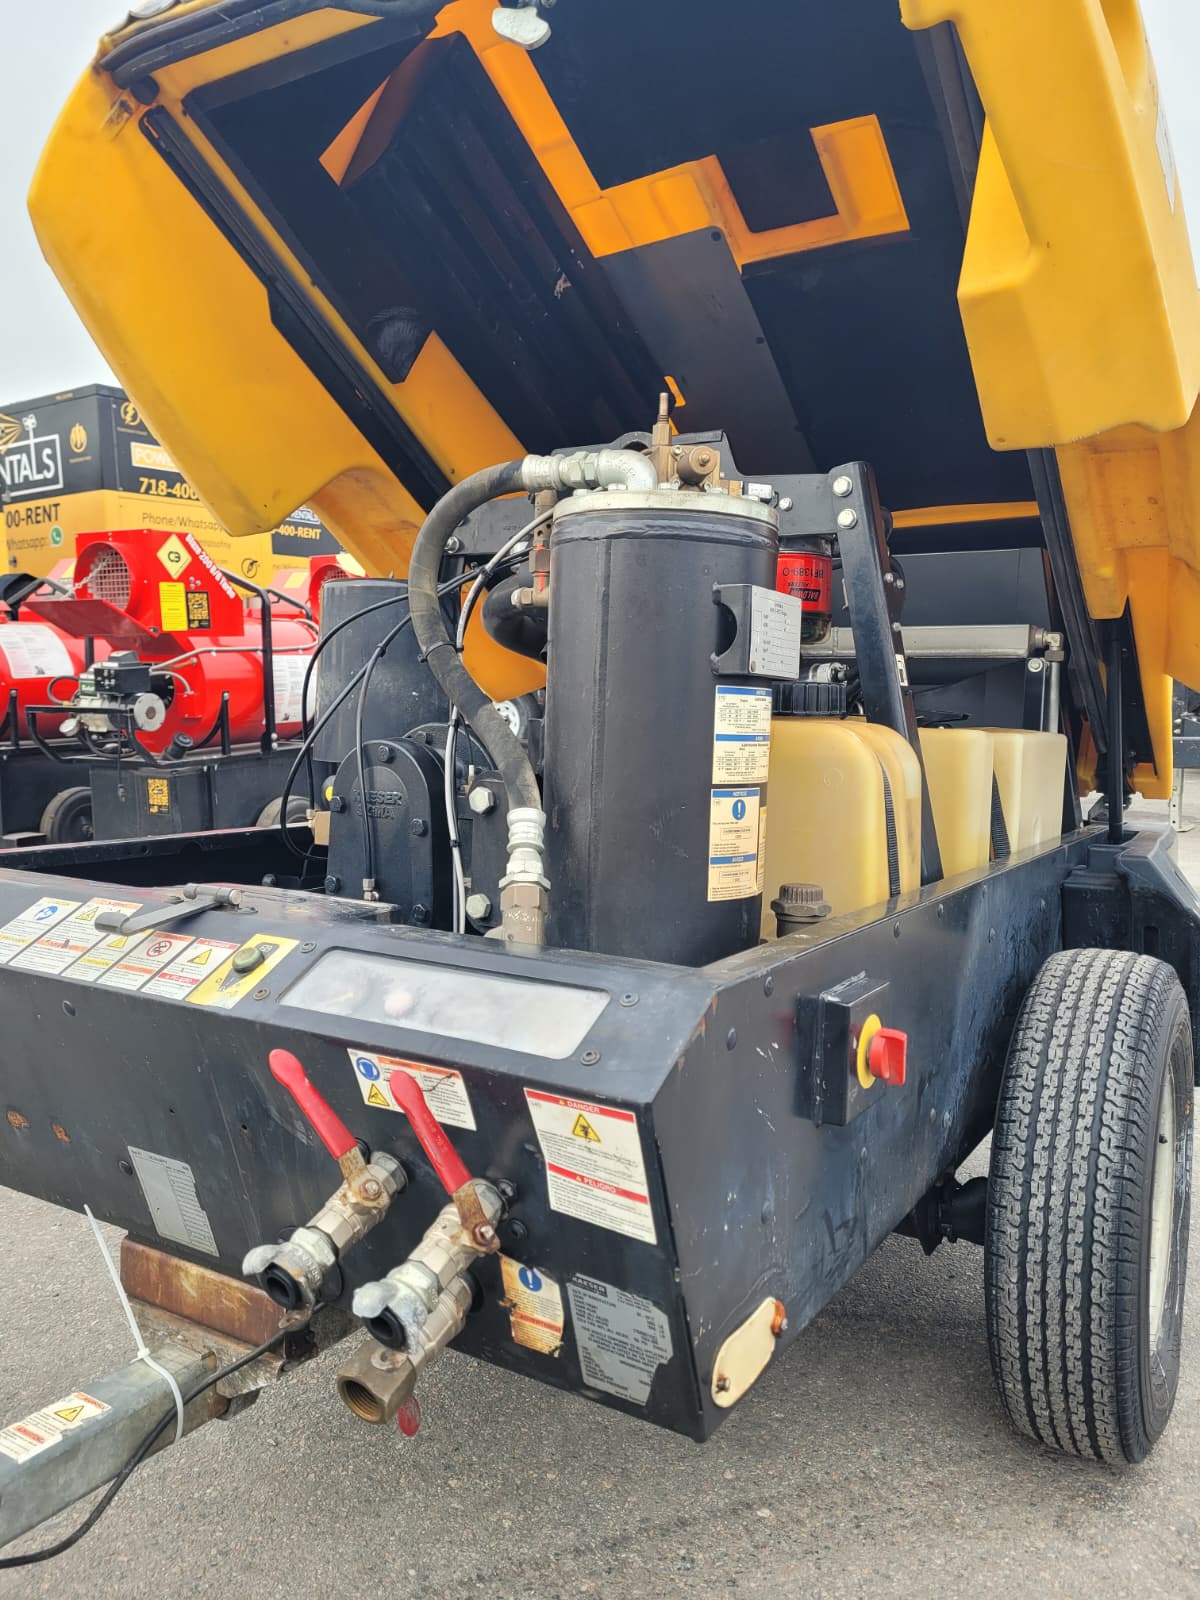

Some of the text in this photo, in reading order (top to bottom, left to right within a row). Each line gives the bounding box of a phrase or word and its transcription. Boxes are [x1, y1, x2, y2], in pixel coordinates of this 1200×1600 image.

[357, 805, 396, 820] SGMA
[567, 1100, 600, 1114] DANGER
[583, 1177, 616, 1194] PELIGRO
